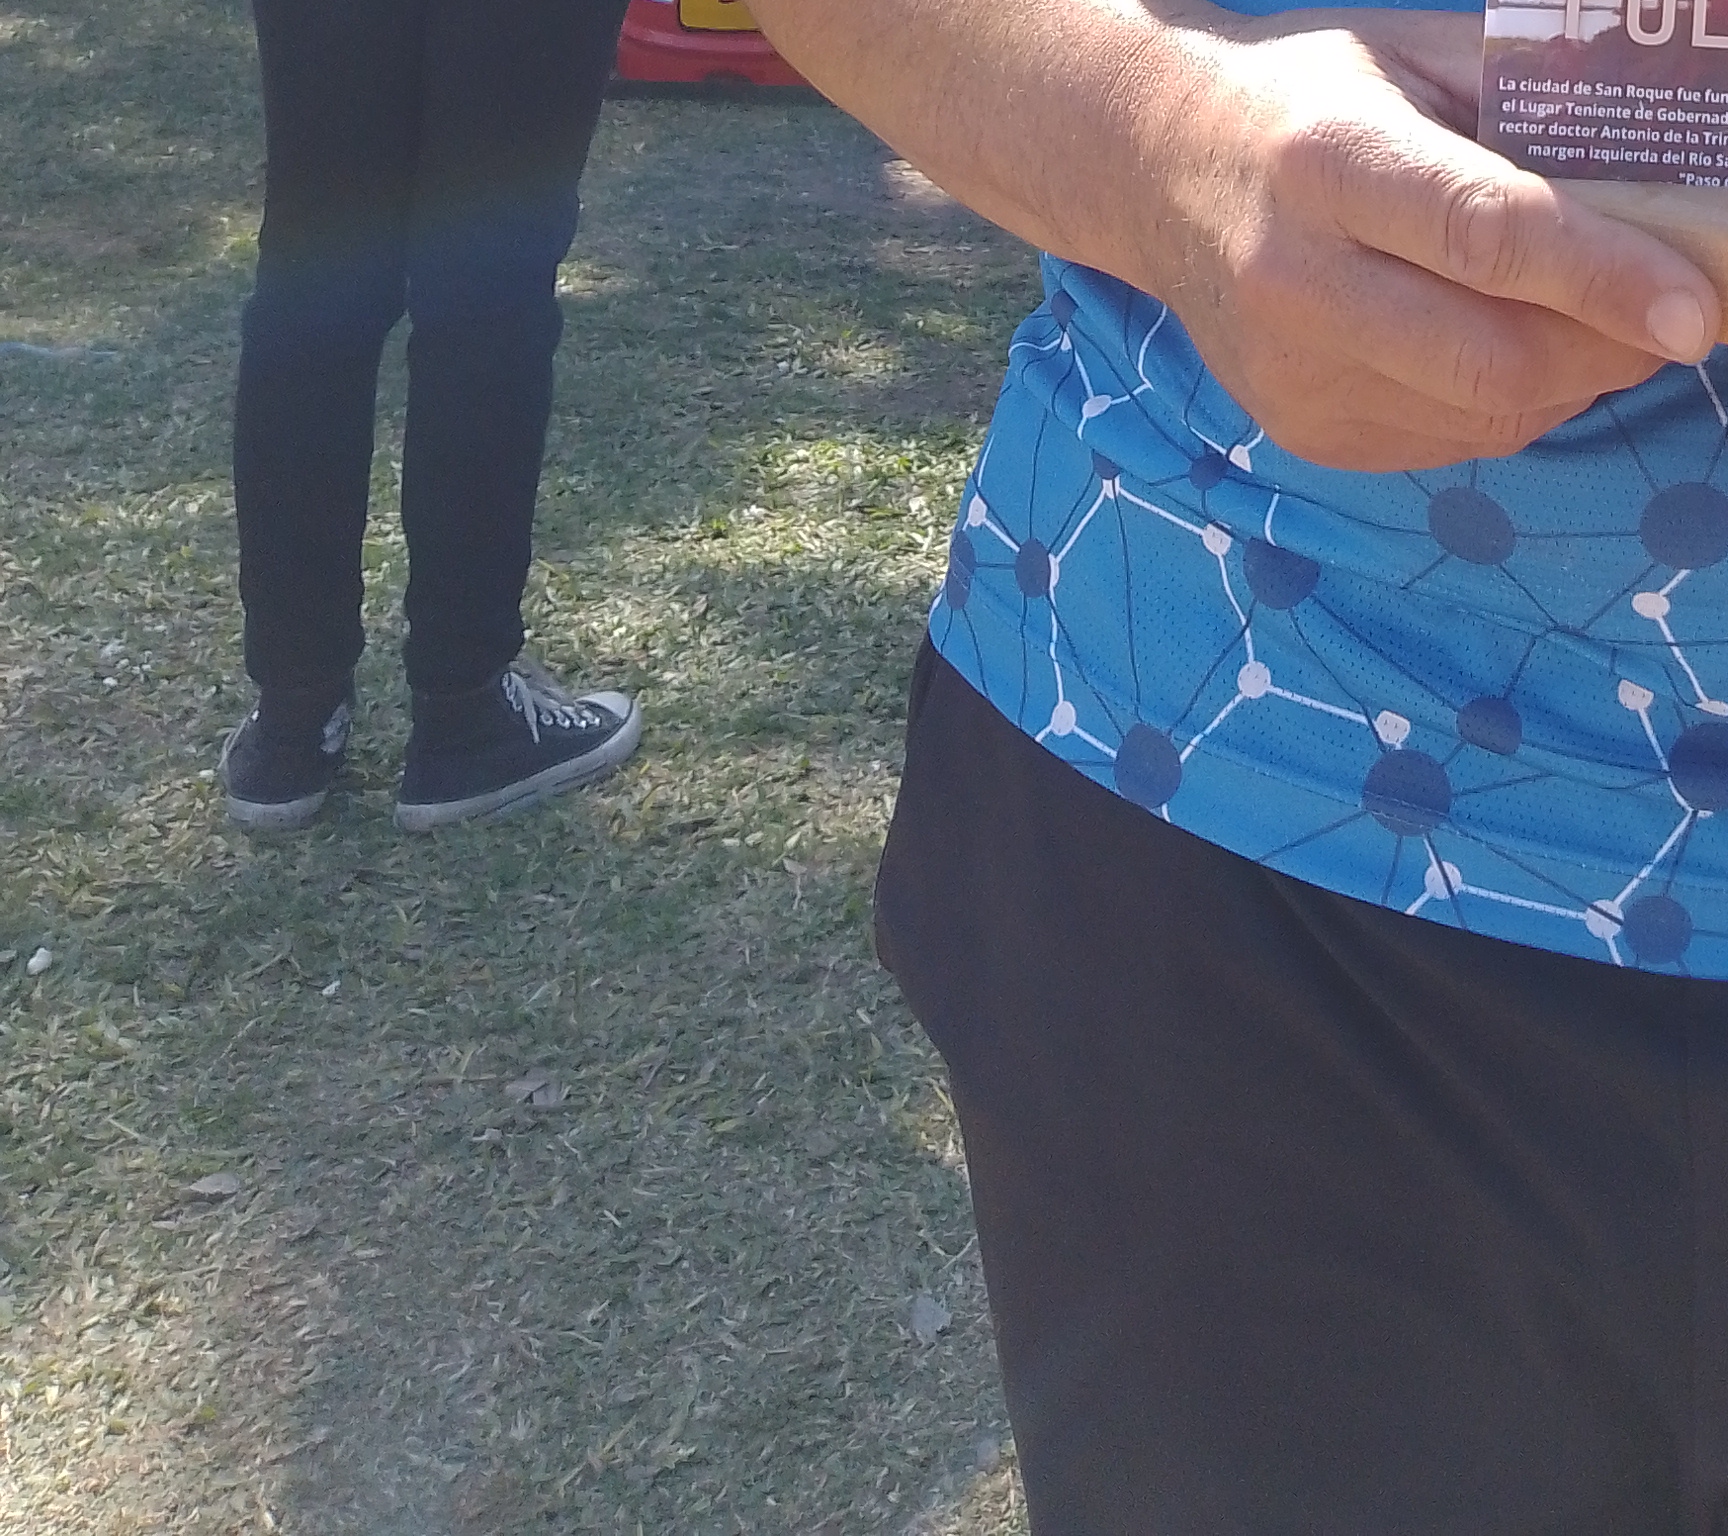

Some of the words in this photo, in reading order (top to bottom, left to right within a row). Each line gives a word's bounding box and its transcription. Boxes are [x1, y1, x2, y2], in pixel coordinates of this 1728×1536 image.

[1499, 76, 1516, 92] La
[1519, 78, 1570, 95] ciudad
[1573, 80, 1592, 96] de
[1595, 82, 1623, 99] San
[1626, 84, 1674, 104] Roque
[1677, 87, 1702, 103] fue
[1502, 98, 1516, 113] el
[1519, 99, 1563, 119] Lugar
[1565, 101, 1632, 120] Teniente
[1635, 105, 1654, 121] de
[1499, 121, 1546, 136] rector
[1548, 122, 1598, 139] doctor
[1600, 126, 1660, 143] Antonio
[1663, 129, 1683, 144] de
[1686, 130, 1699, 146] la
[1527, 144, 1585, 162] margen
[1589, 145, 1659, 165] izquierda
[1662, 149, 1685, 166] del
[1688, 152, 1712, 168] Río
[1679, 172, 1721, 187] "Paso
